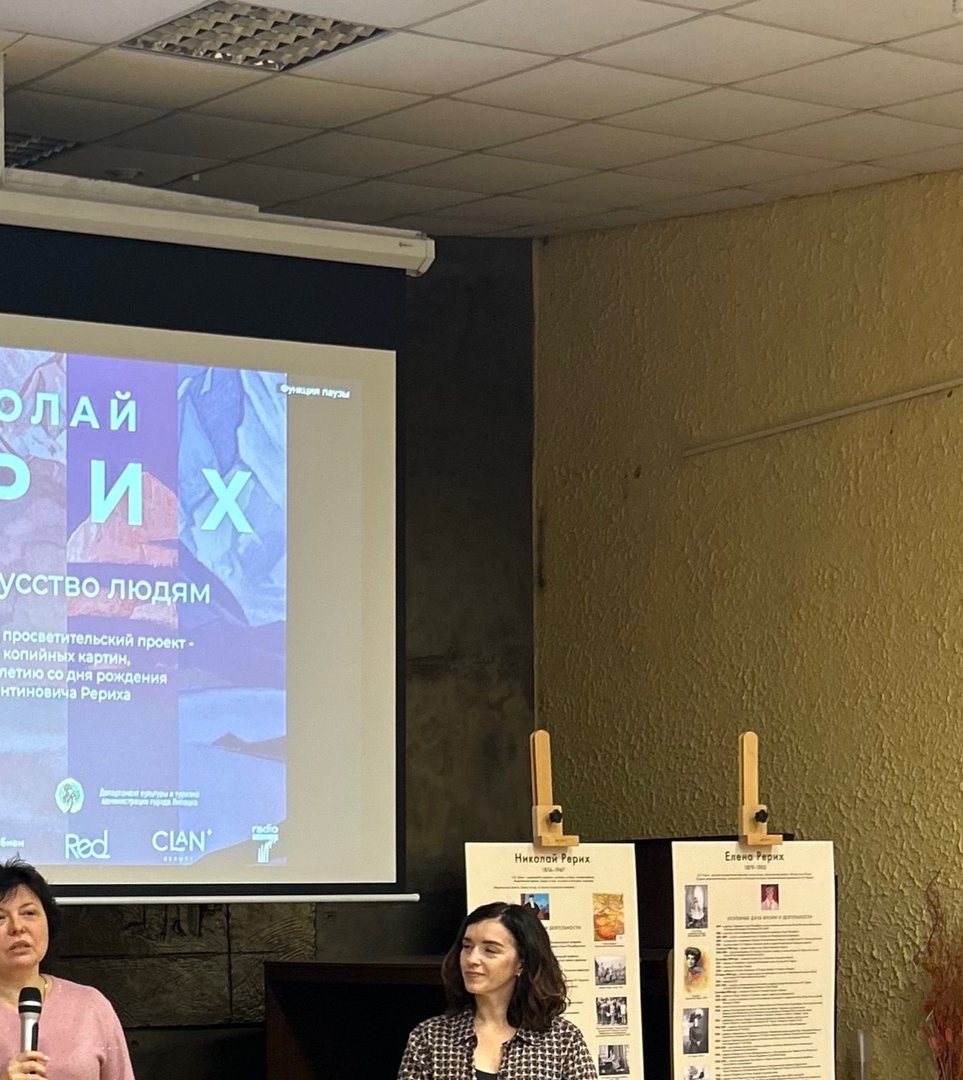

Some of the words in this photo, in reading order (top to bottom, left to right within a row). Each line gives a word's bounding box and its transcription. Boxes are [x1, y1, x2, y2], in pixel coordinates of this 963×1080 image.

[280, 384, 320, 396] Функция
[322, 388, 350, 399] паузы
[108, 578, 211, 606] людям
[3, 630, 133, 647] просветительский
[138, 637, 186, 650] проект
[4, 648, 75, 663] копийных
[78, 652, 131, 666] картин,
[47, 669, 64, 681] со
[66, 670, 93, 682] дня
[96, 671, 168, 684] рождения
[81, 686, 131, 702] Рериха
[251, 823, 279, 834] radio
[65, 830, 111, 859] Red
[151, 830, 205, 852] CLAN
[514, 852, 558, 864] Николай
[561, 853, 591, 866] Рерих
[725, 851, 754, 862] Елена
[756, 851, 785, 863] Рерих
